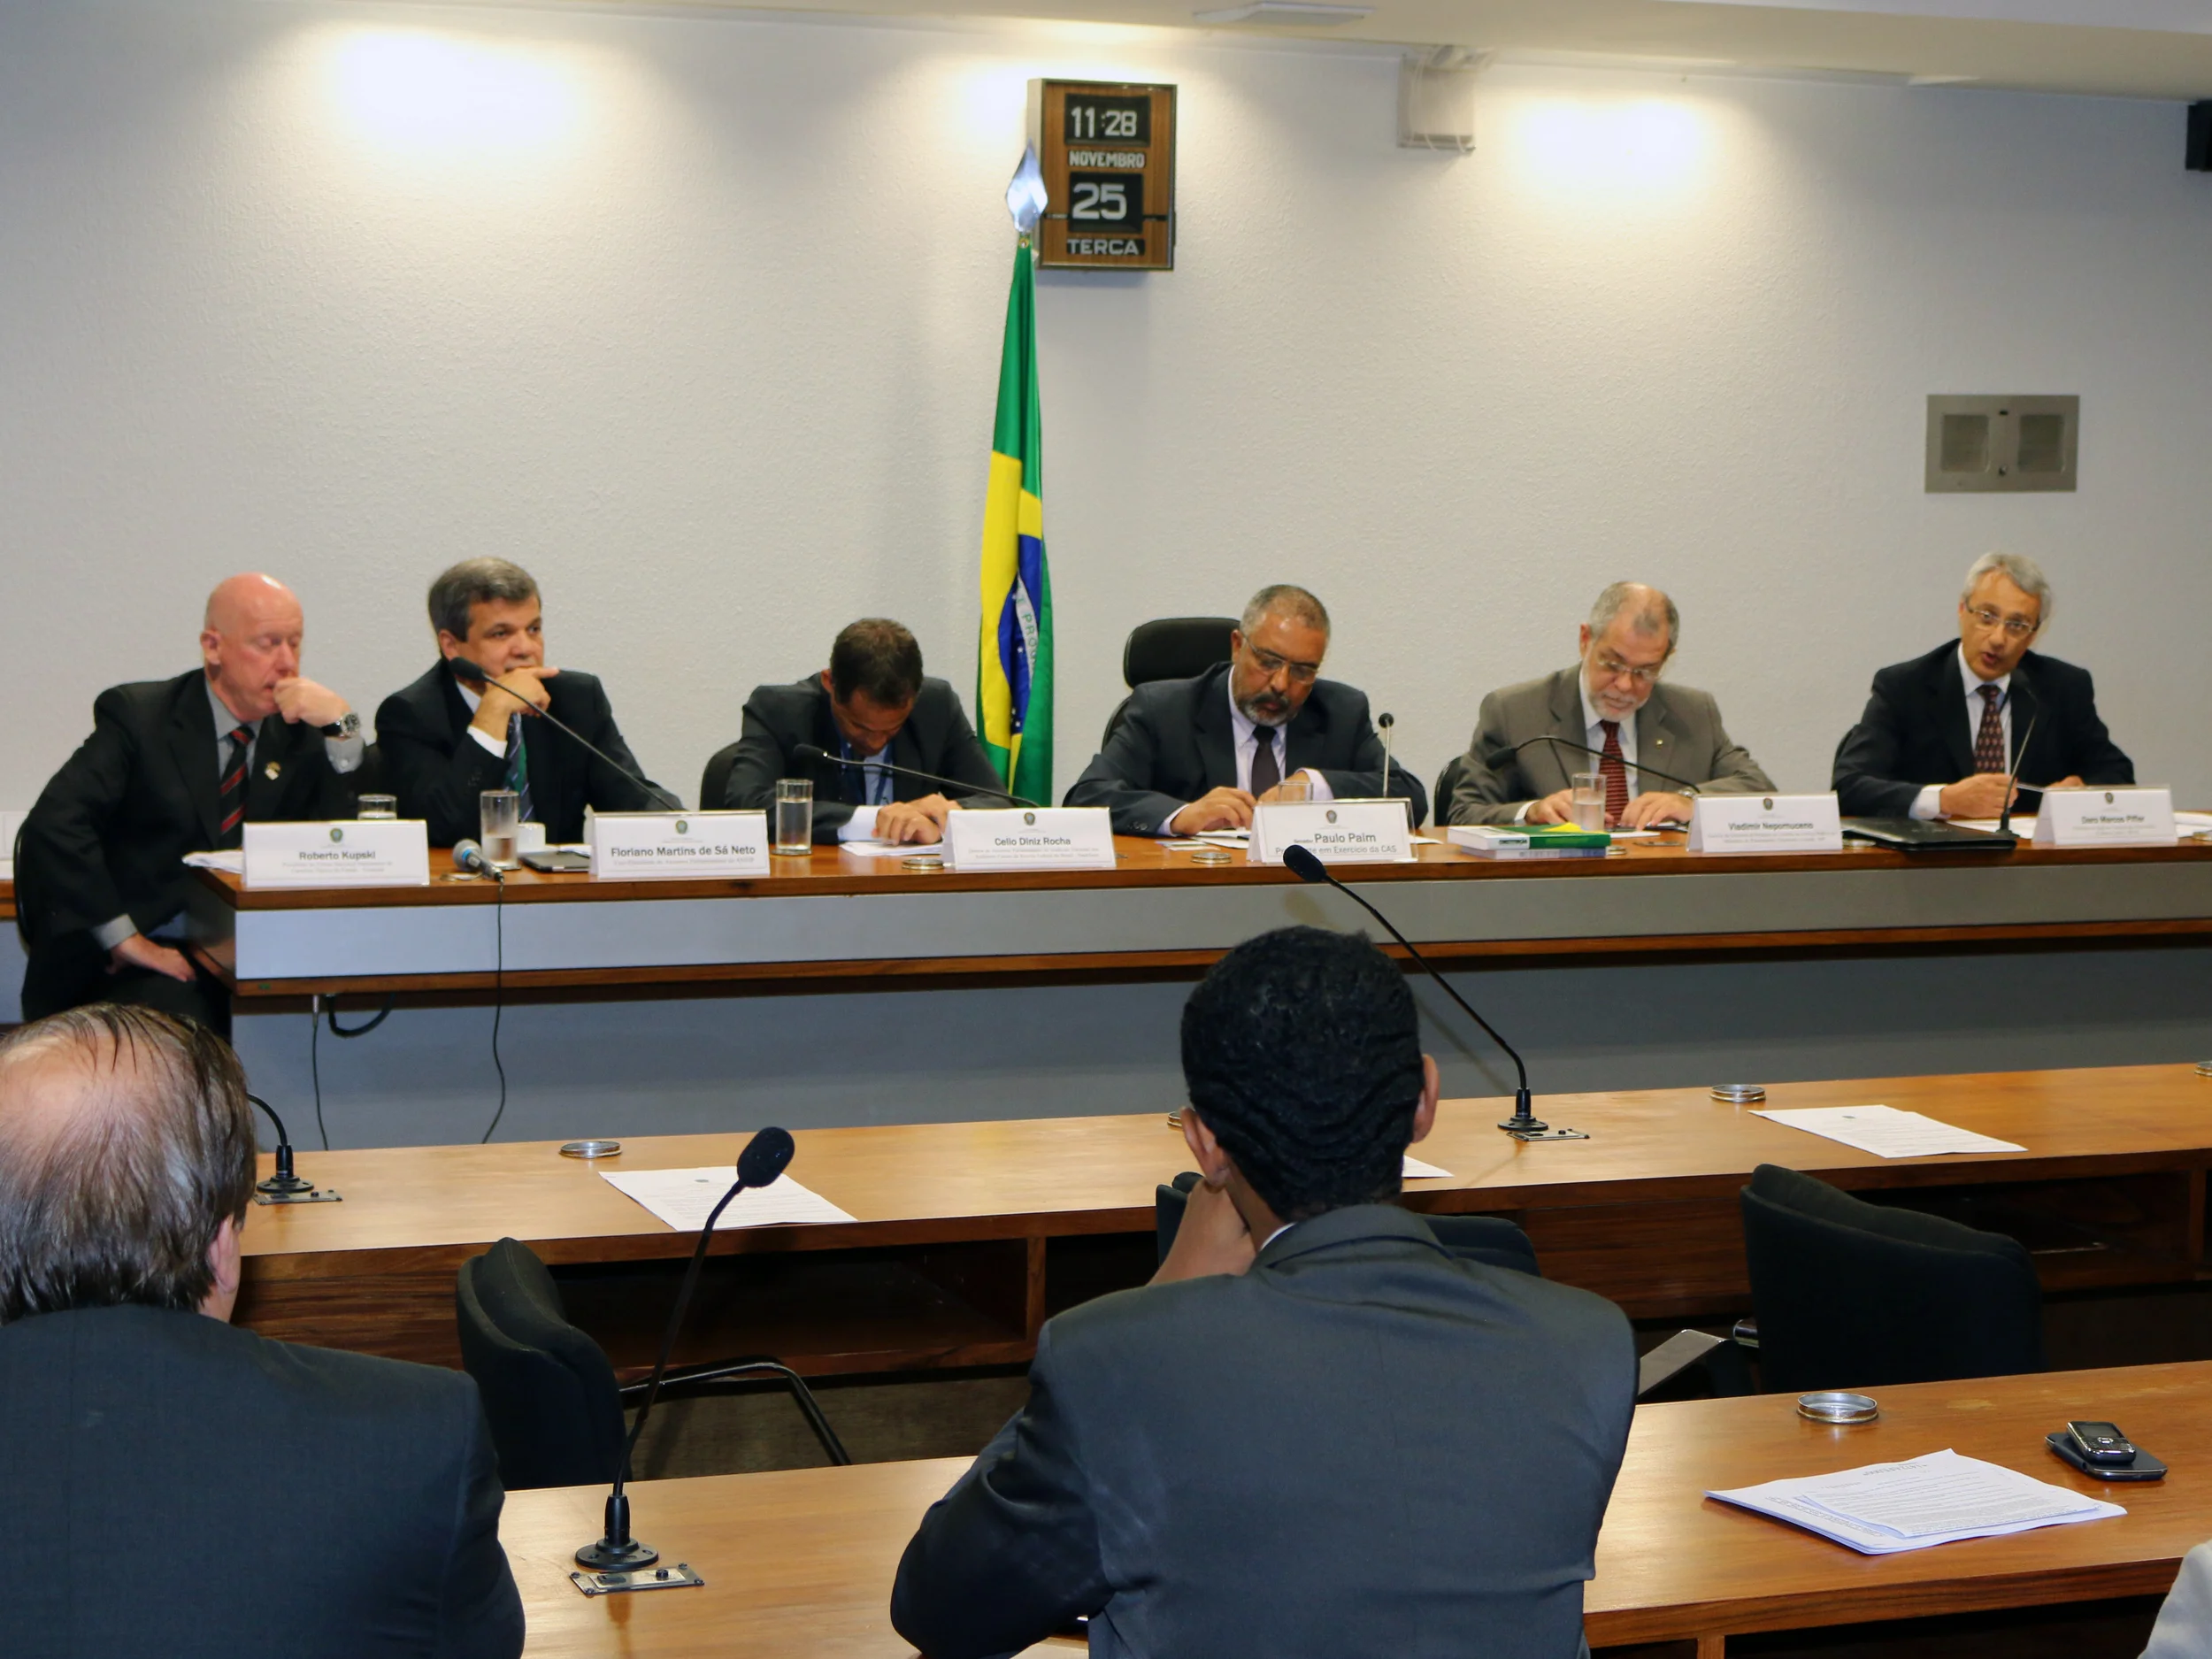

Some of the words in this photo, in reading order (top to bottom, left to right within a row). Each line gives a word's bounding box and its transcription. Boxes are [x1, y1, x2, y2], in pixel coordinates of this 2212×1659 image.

[1071, 106, 1137, 138] 11:28
[1069, 150, 1146, 168] NOVEMBRO
[1071, 182, 1127, 220] 25
[1067, 239, 1140, 256] TERCA
[1018, 836, 1041, 846] Diniz
[1043, 836, 1071, 846] Rocha
[1314, 833, 1346, 843] Paulo
[1348, 832, 1377, 843] Paim
[611, 847, 654, 857] Floriano
[657, 846, 696, 856] Martins
[698, 845, 712, 856] de
[714, 845, 728, 856] Sá
[731, 844, 757, 856] Neto
[1380, 844, 1397, 853] CAS
[299, 850, 339, 861] Roberto
[342, 849, 376, 862] Kupski
